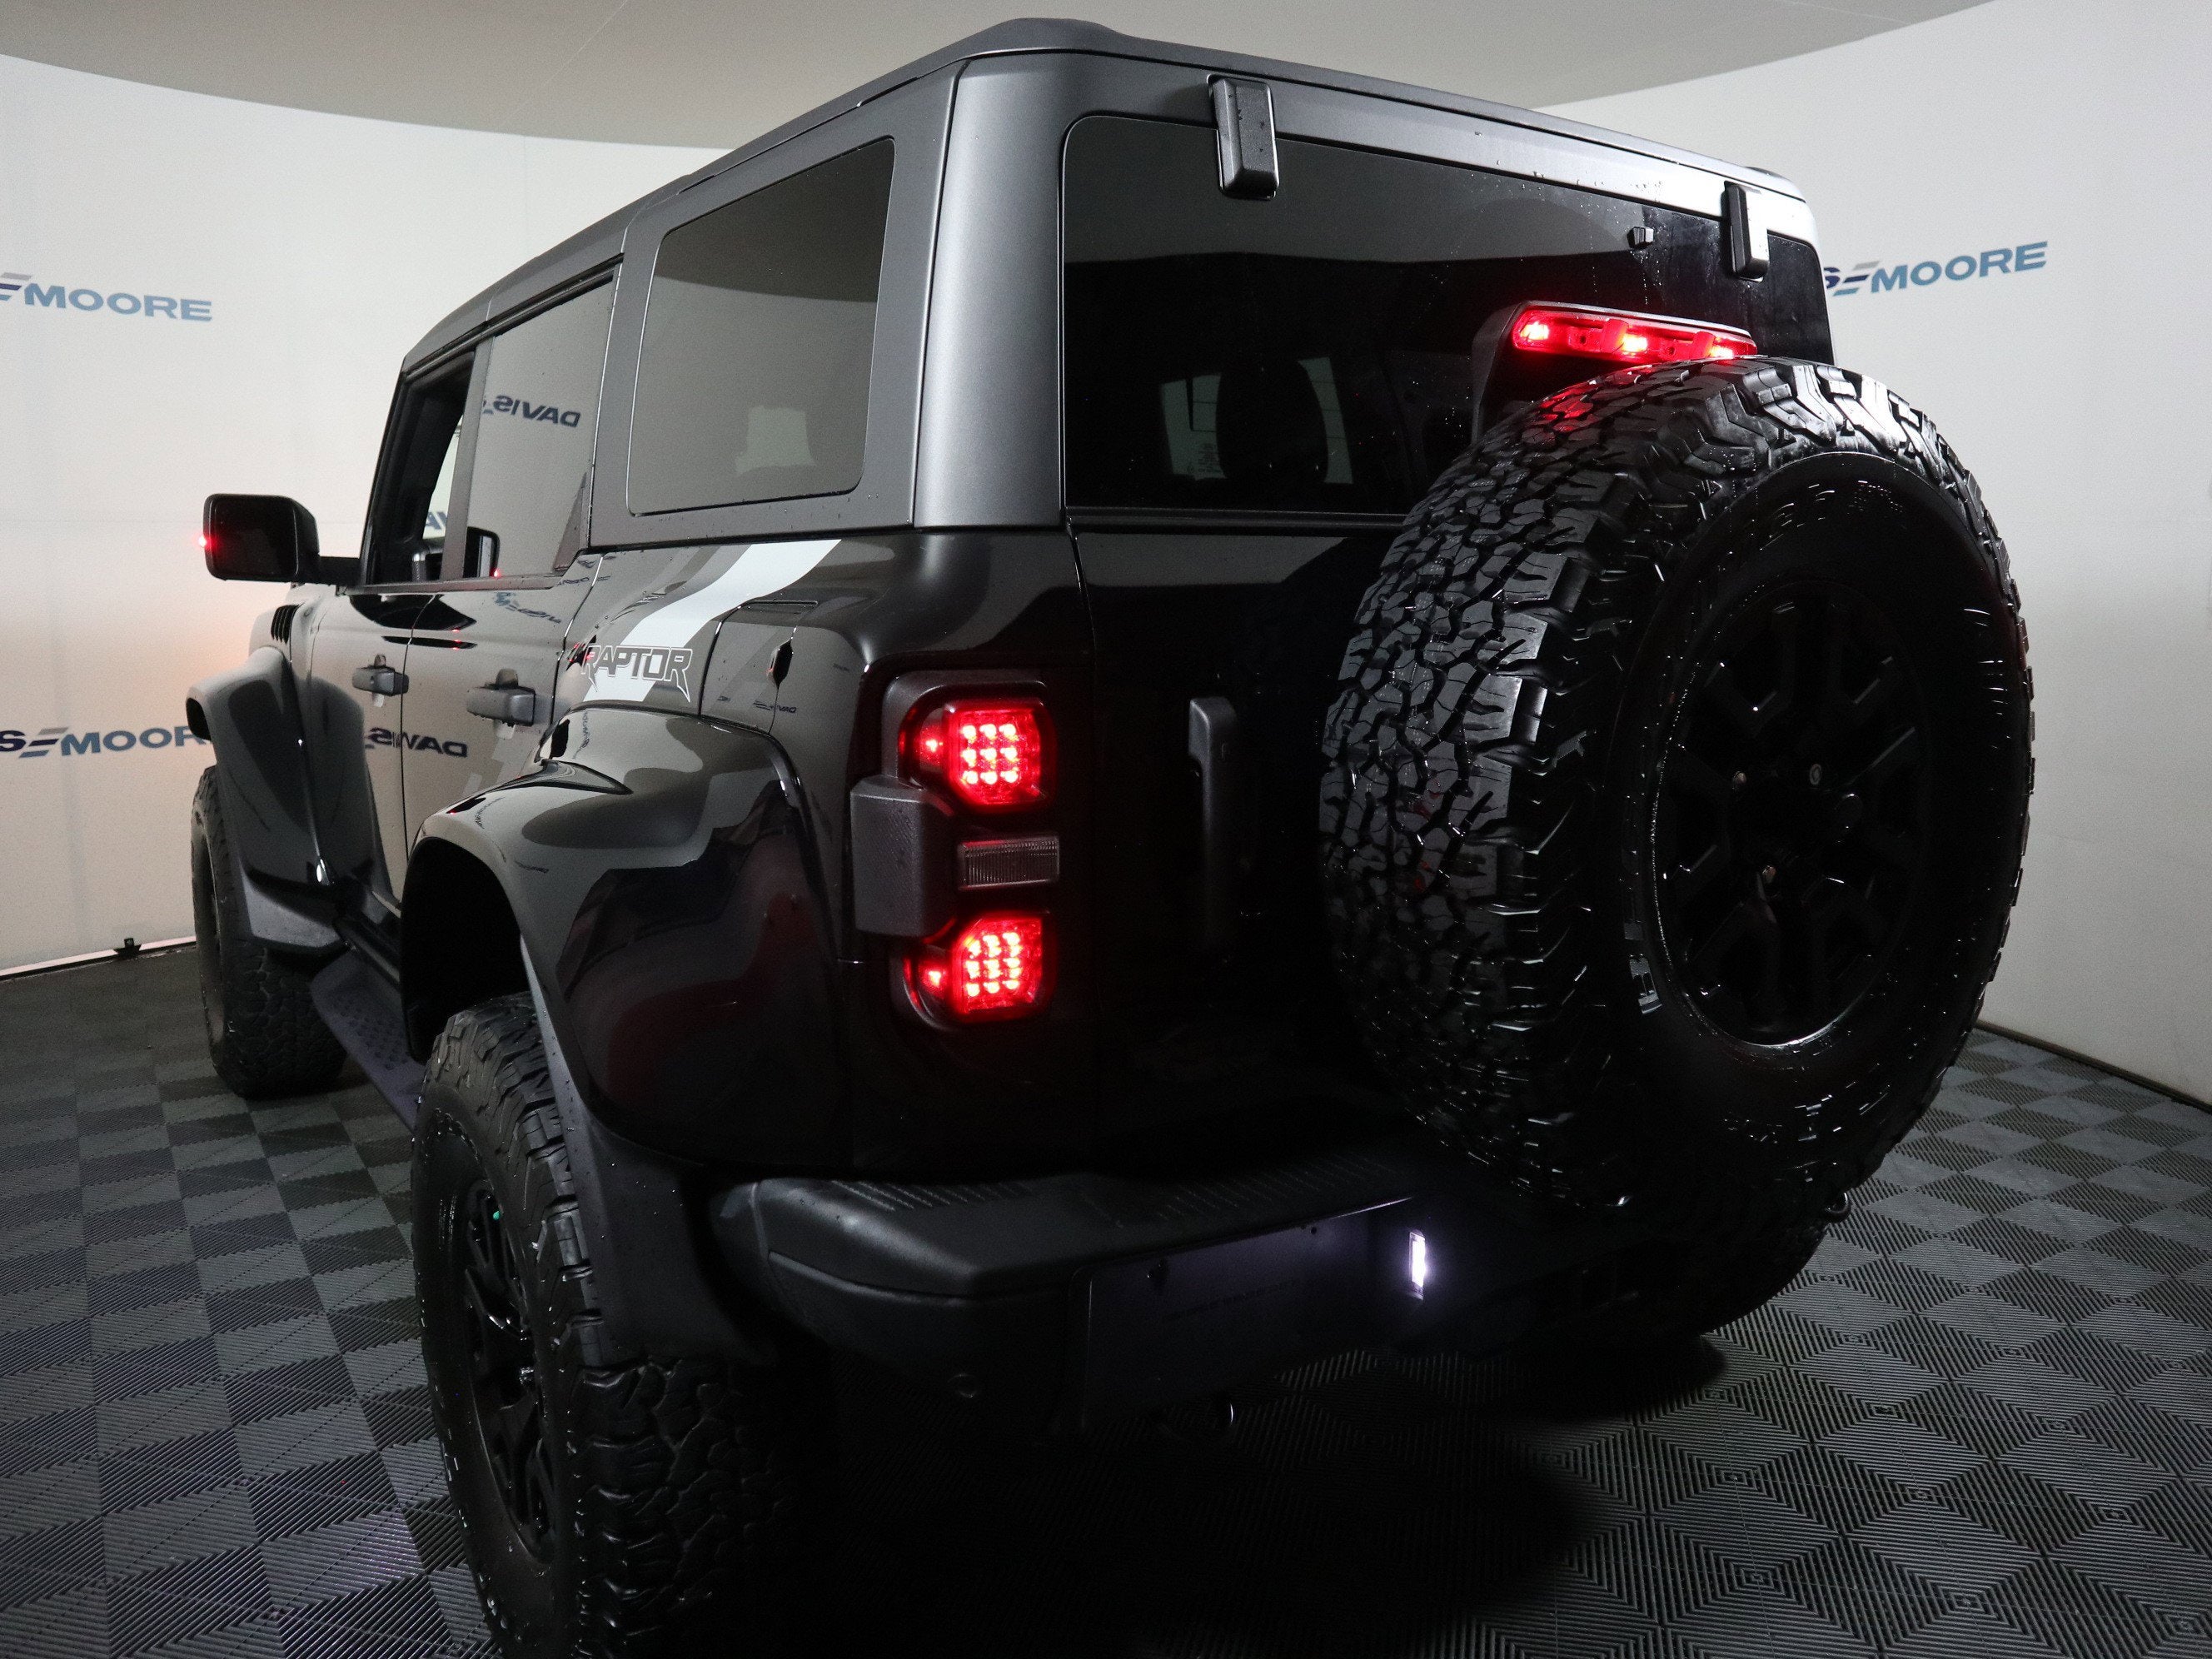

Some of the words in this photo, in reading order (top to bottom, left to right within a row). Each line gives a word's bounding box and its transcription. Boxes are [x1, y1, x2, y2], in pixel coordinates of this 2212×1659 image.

[1871, 241, 2048, 293] MOORE
[24, 283, 212, 321] MOORE
[580, 645, 695, 703] RAPTOR
[61, 725, 207, 756] MOOR
